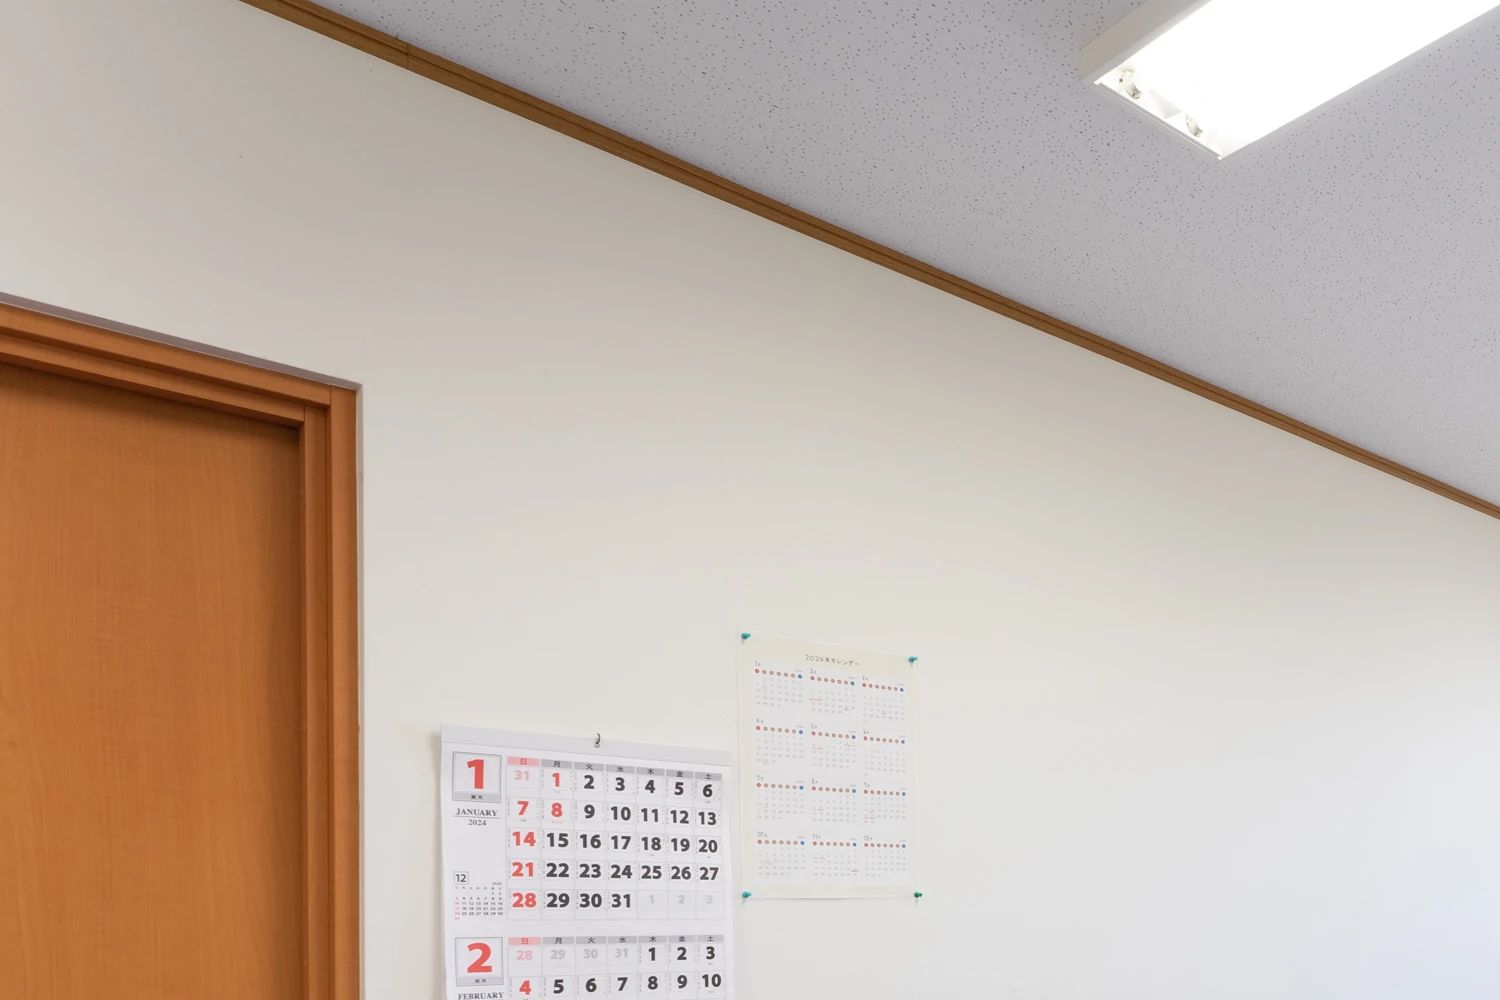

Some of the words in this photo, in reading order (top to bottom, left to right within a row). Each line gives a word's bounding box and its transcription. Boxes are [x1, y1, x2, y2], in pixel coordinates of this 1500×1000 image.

[467, 758, 484, 789] 1
[515, 770, 529, 781] 31
[552, 773, 560, 787] 1
[584, 775, 594, 789] 2
[616, 777, 625, 791] 3
[645, 780, 655, 793] 4
[675, 782, 683, 795] 5
[703, 784, 712, 797] 6
[456, 808, 498, 816] JANUARY
[518, 801, 528, 815] 7
[551, 803, 563, 817] 8
[584, 805, 595, 818] 9
[611, 806, 631, 821] 10
[641, 808, 658, 822] 11
[671, 810, 689, 824] 12
[699, 812, 716, 825] 13
[513, 832, 536, 846] 14
[547, 833, 568, 847] 15
[580, 834, 601, 848] 16
[611, 836, 631, 849] 17
[642, 837, 661, 850] 18
[671, 838, 690, 851] 19
[699, 839, 717, 853] 20
[456, 874, 466, 882] 12
[512, 862, 533, 877] 21
[546, 863, 569, 877] 22
[580, 864, 601, 878] 23
[611, 865, 632, 878] 24
[642, 865, 661, 879] 25
[671, 866, 691, 880] 26
[700, 867, 718, 880] 27
[513, 893, 536, 907] 28
[547, 893, 569, 907] 29
[580, 893, 602, 907] 30
[612, 894, 630, 908] 31
[649, 895, 654, 904] 1
[678, 895, 685, 904] 2
[706, 895, 712, 904] 3
[467, 942, 492, 973] 2
[517, 950, 532, 960] 28
[550, 950, 566, 959] 29
[584, 949, 598, 959] 30
[615, 948, 628, 958] 31
[649, 948, 655, 961] 1
[677, 947, 686, 960] 2
[706, 946, 715, 959] 3
[519, 980, 531, 995] 4
[554, 979, 564, 994] 5
[586, 978, 596, 992] 6
[618, 977, 627, 991] 7
[648, 976, 658, 990] 8
[677, 975, 687, 988] 9
[702, 974, 721, 987] 10
[458, 992, 504, 1000] FEBRUARY
